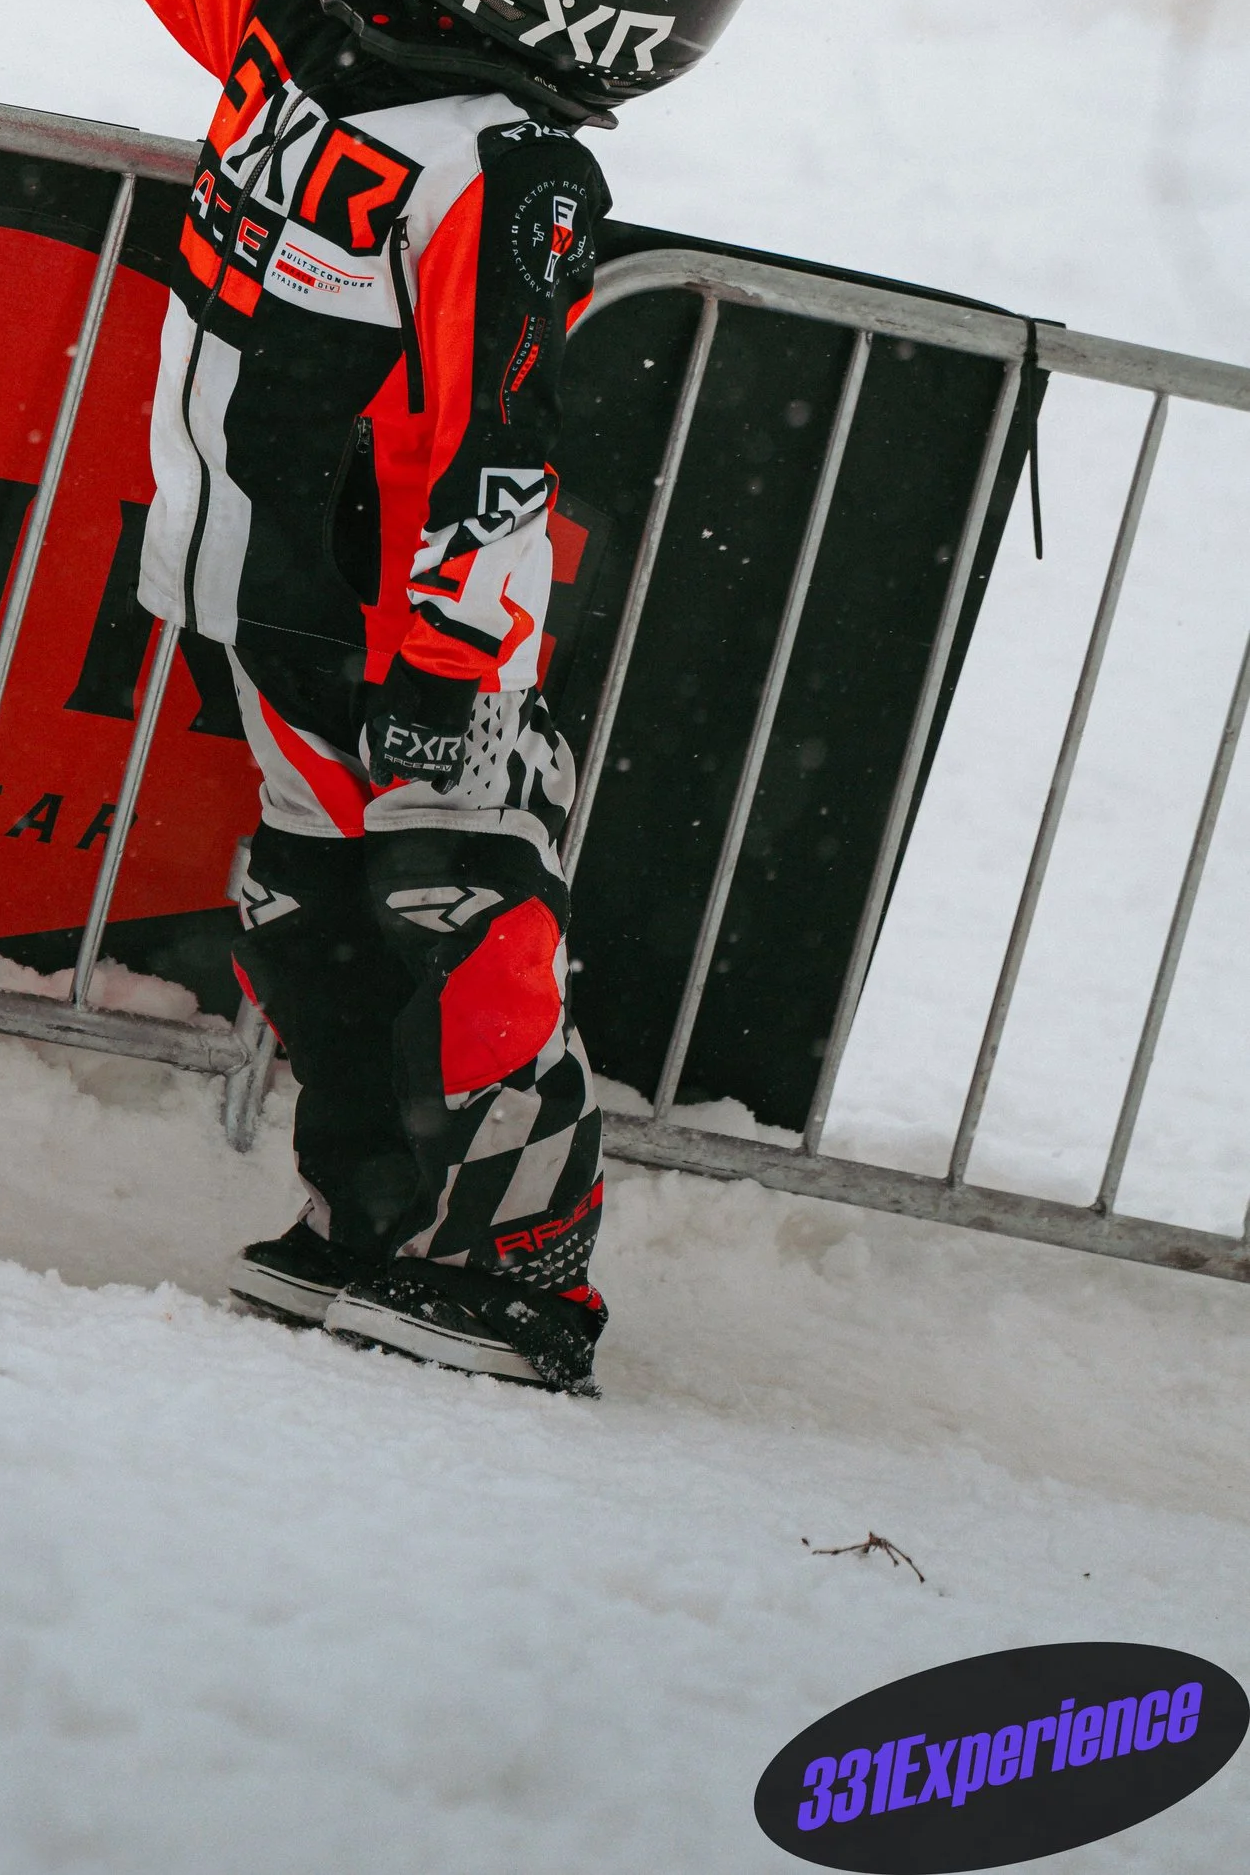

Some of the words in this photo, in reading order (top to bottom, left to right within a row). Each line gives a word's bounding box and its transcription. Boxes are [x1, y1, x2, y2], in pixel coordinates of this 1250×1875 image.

[514, 180, 556, 221] FACTORY
[280, 249, 308, 268] BUILT
[320, 270, 373, 288] CONQUER
[511, 239, 542, 293] FACTORY
[384, 725, 462, 761] FXR
